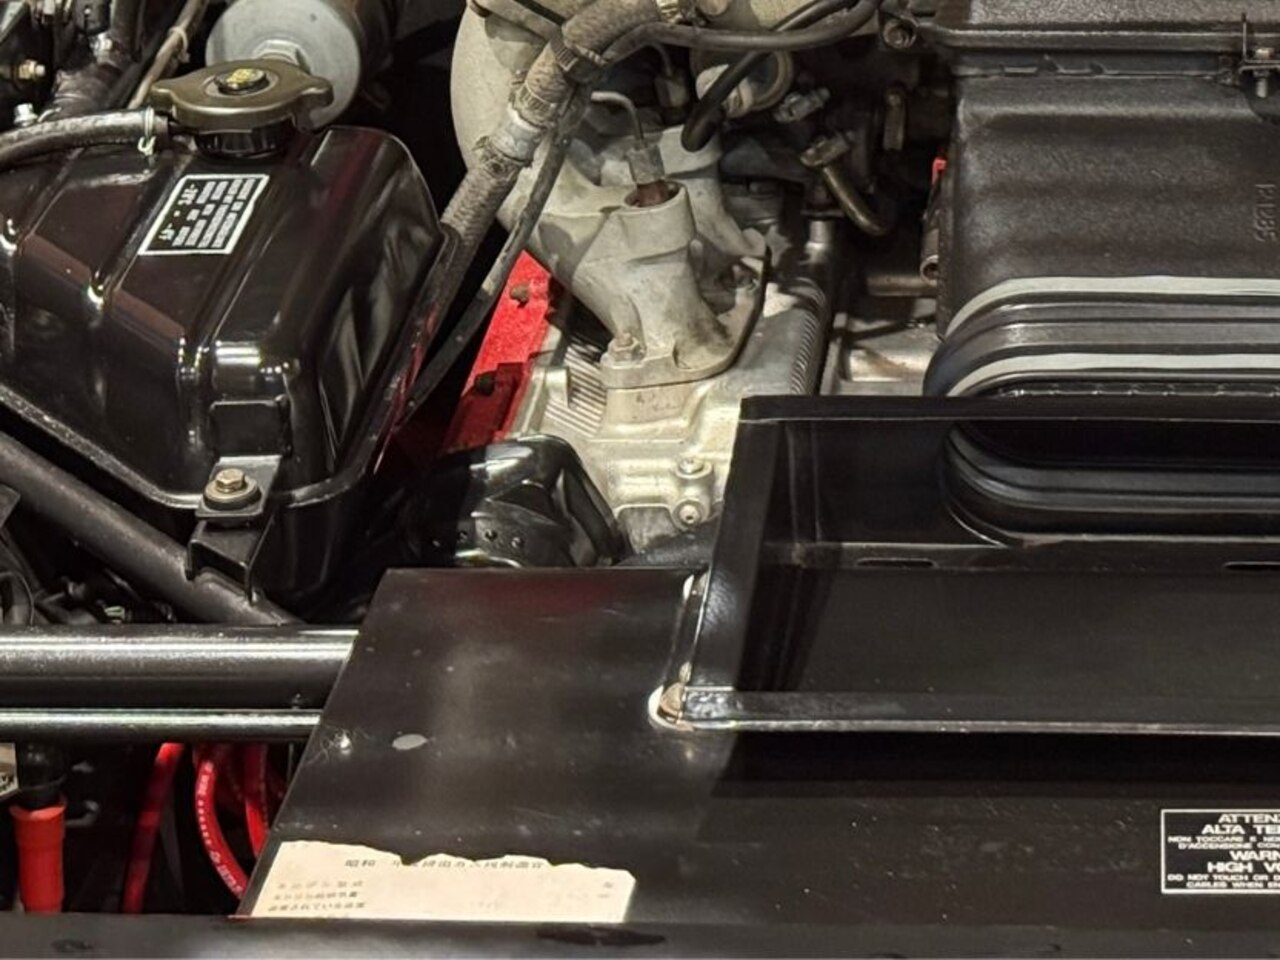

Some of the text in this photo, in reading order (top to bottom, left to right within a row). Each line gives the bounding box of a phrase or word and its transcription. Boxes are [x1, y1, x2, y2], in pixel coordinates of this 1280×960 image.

[1201, 824, 1245, 835] ALTA
[1168, 835, 1192, 843] NON
[1196, 835, 1243, 843] TOCCARE
[1257, 842, 1280, 850] CON
[1207, 861, 1253, 873] HIGH
[1167, 873, 1184, 881] DO
[1187, 873, 1209, 881] NOT
[1212, 873, 1248, 881] TOUCH
[1252, 873, 1269, 881] OR
